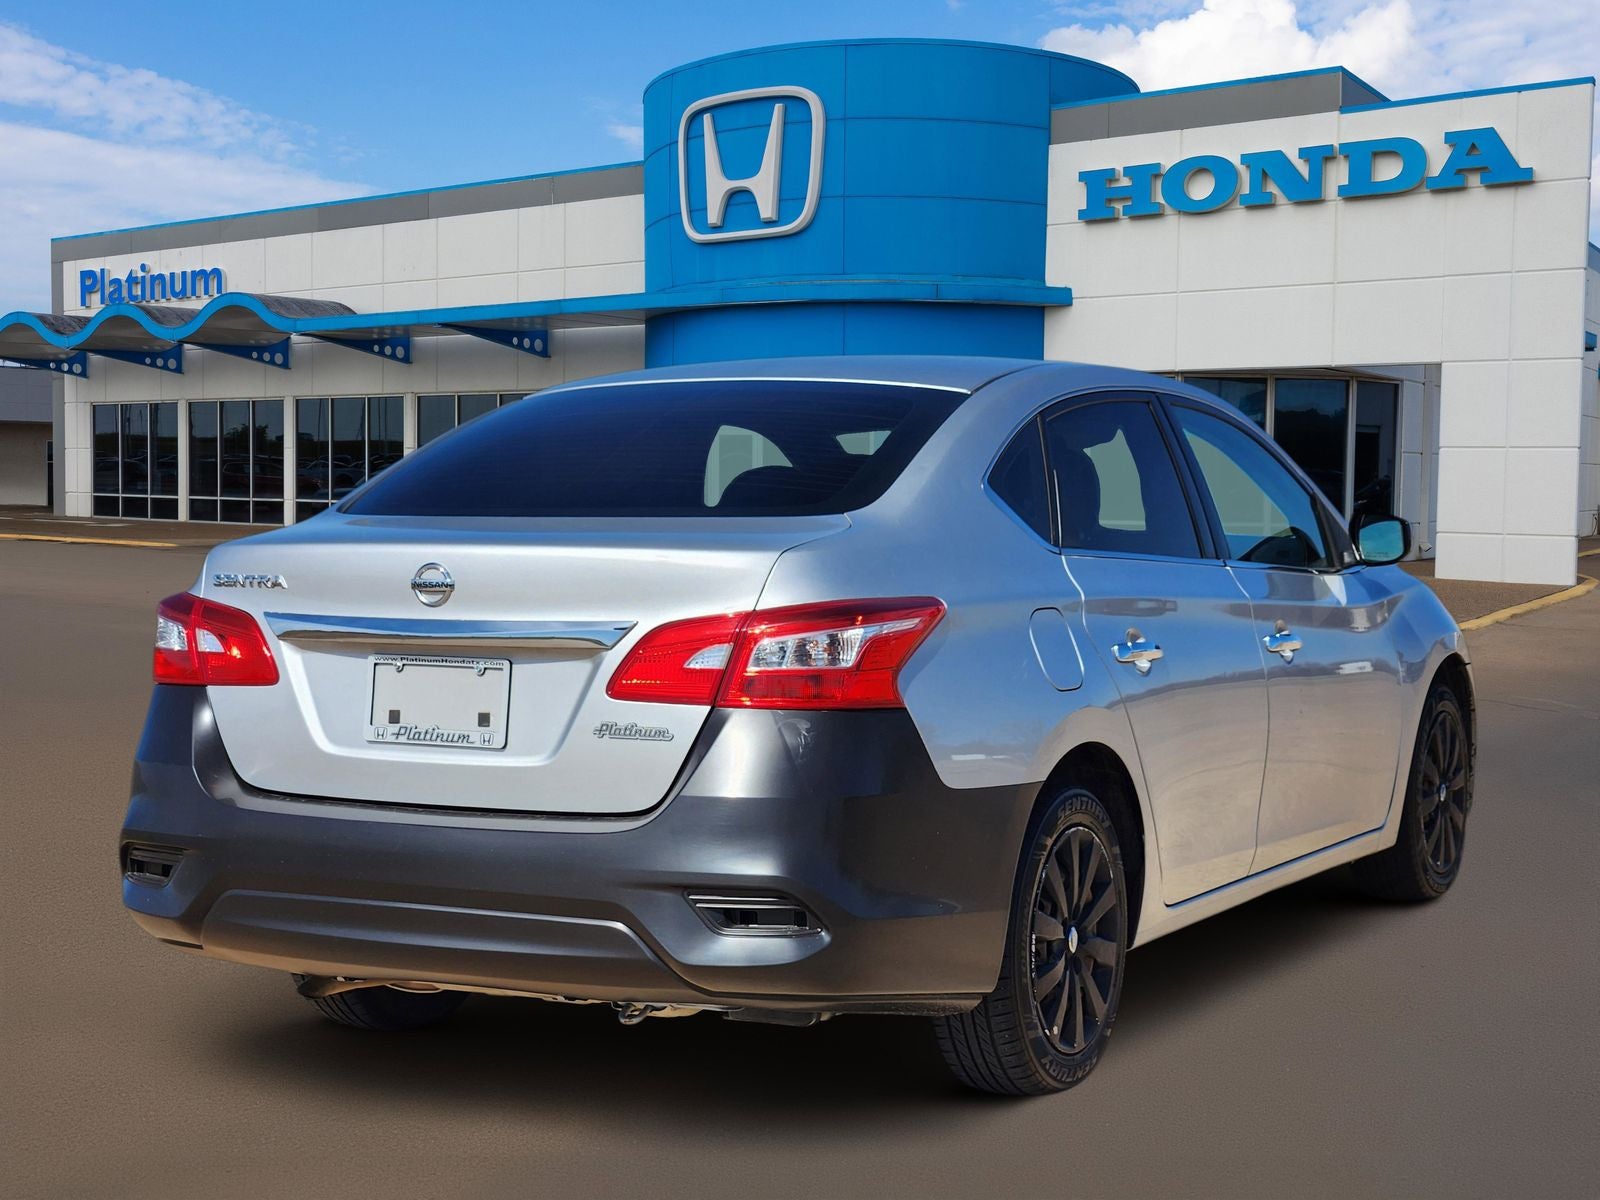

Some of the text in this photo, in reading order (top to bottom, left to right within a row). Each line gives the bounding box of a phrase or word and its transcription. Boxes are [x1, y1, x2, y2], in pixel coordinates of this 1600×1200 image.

[1078, 126, 1534, 222] HONDA
[79, 262, 226, 308] Platinum
[213, 573, 288, 589] SENTRA
[413, 580, 450, 589] NISSAN
[391, 725, 476, 745] Platinum
[593, 722, 674, 741] Platinum
